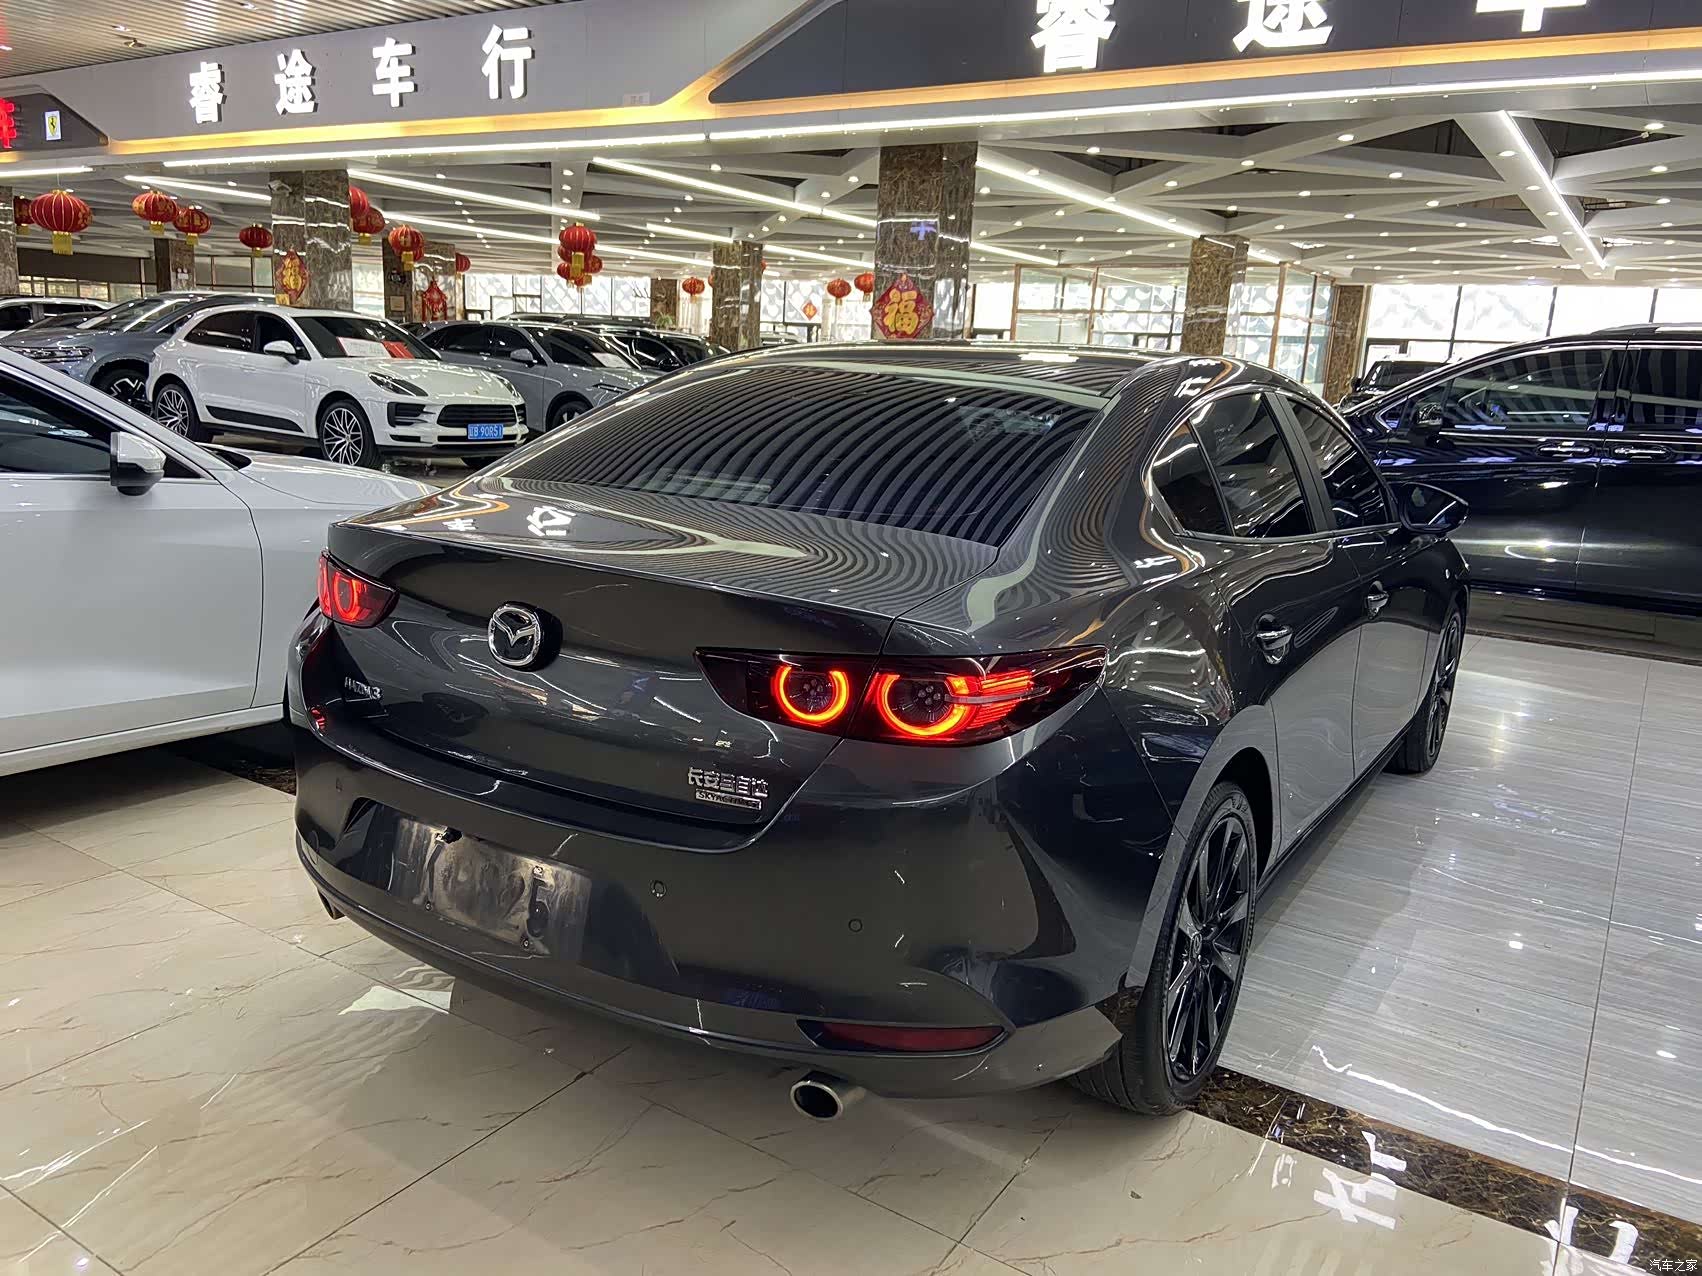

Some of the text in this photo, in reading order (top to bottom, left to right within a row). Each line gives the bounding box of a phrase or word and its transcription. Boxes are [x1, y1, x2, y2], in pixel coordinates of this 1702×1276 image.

[189, 23, 534, 124] 睿途车行
[883, 288, 919, 335] 福
